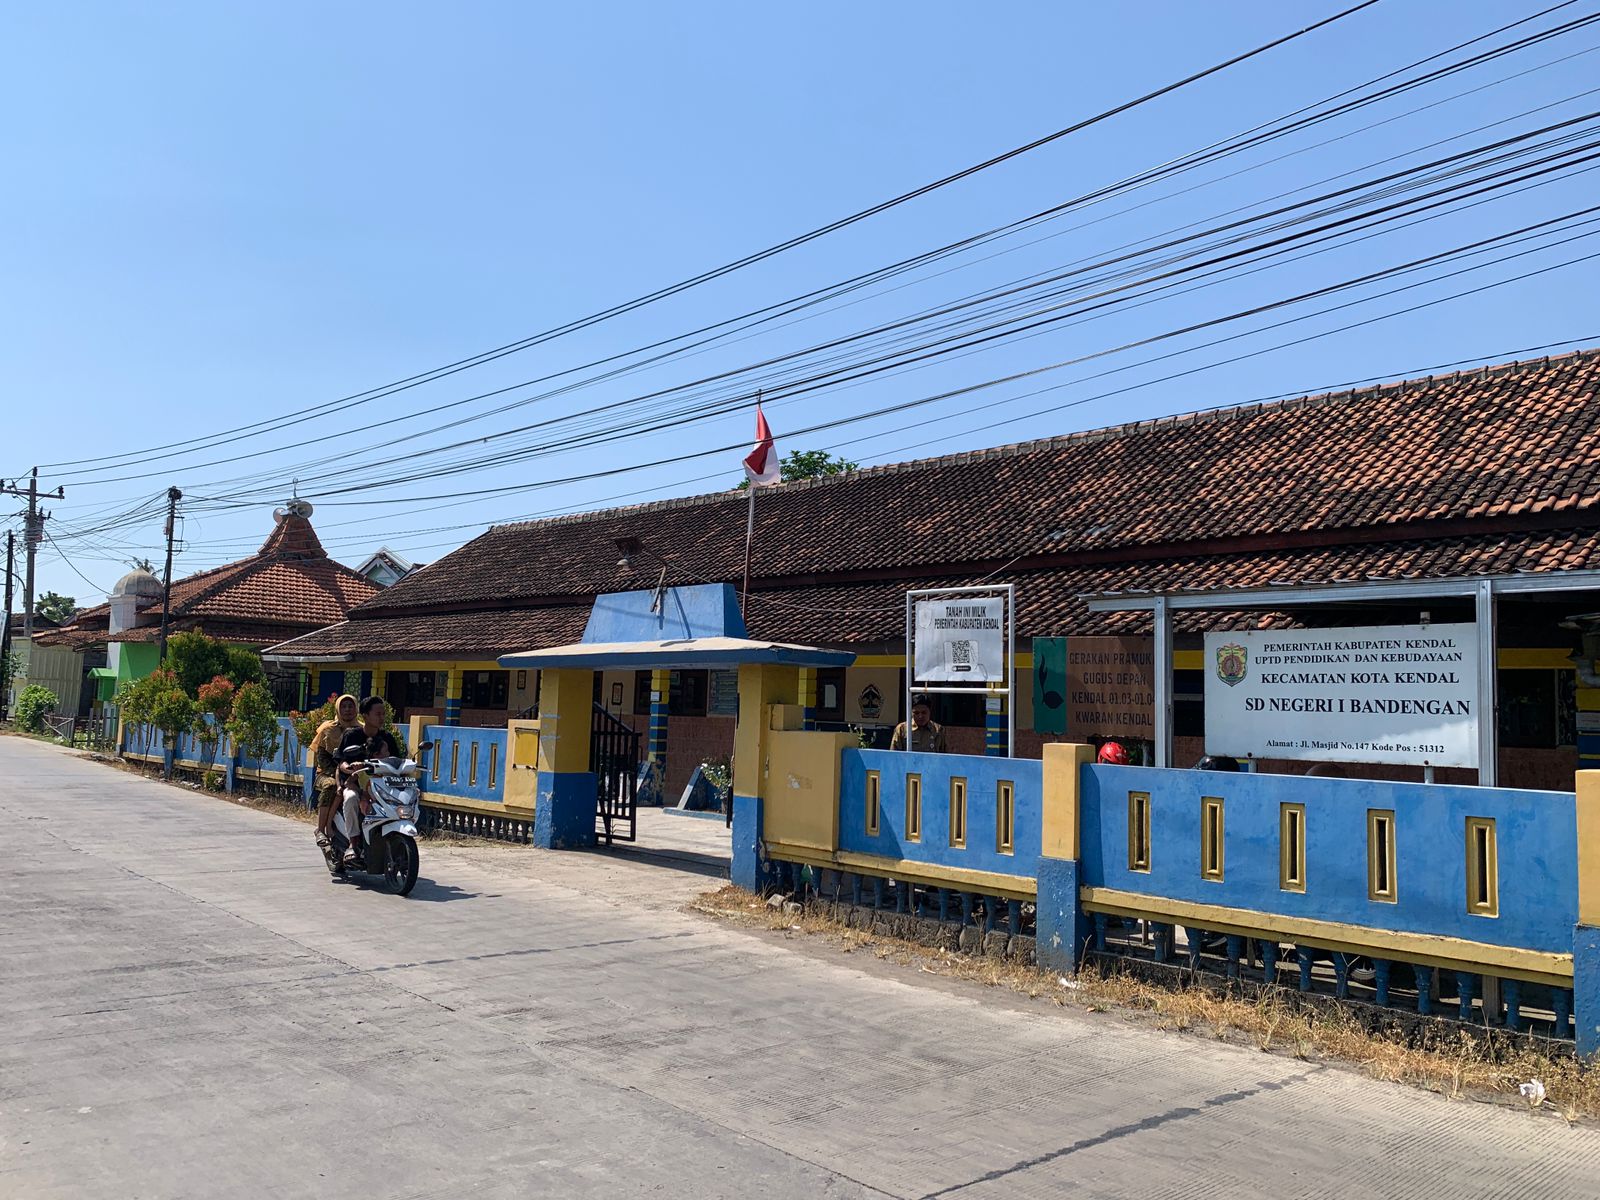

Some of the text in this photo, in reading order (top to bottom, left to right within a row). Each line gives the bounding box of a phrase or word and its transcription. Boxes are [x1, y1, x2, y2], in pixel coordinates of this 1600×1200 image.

[946, 606, 962, 618] TANAH
[972, 606, 986, 618] MILIK
[934, 618, 1000, 630] PEMERINTAH KABUPATEN KENDAL
[1264, 639, 1456, 652] PEMERINTAH KABUPATEN KENDAL
[1070, 652, 1110, 664] GERAKAN
[1255, 652, 1462, 664] UPTD PENDIDIKAN DAN KEBUDAYAAN
[1083, 672, 1146, 686] GUGUS DEPAN
[1261, 672, 1460, 684] KECAMATAN KOTA KENDAL
[1072, 692, 1106, 704] KENDAL
[1245, 697, 1470, 715] SD NEGERI I BANDENGAN
[1075, 711, 1152, 726] KWARAN KENDAL
[1311, 741, 1338, 750] Masjid
[1340, 742, 1369, 750] No.147
[1371, 743, 1394, 751] Kode
[1396, 744, 1411, 752] Pos
[1419, 744, 1445, 753] 51312
